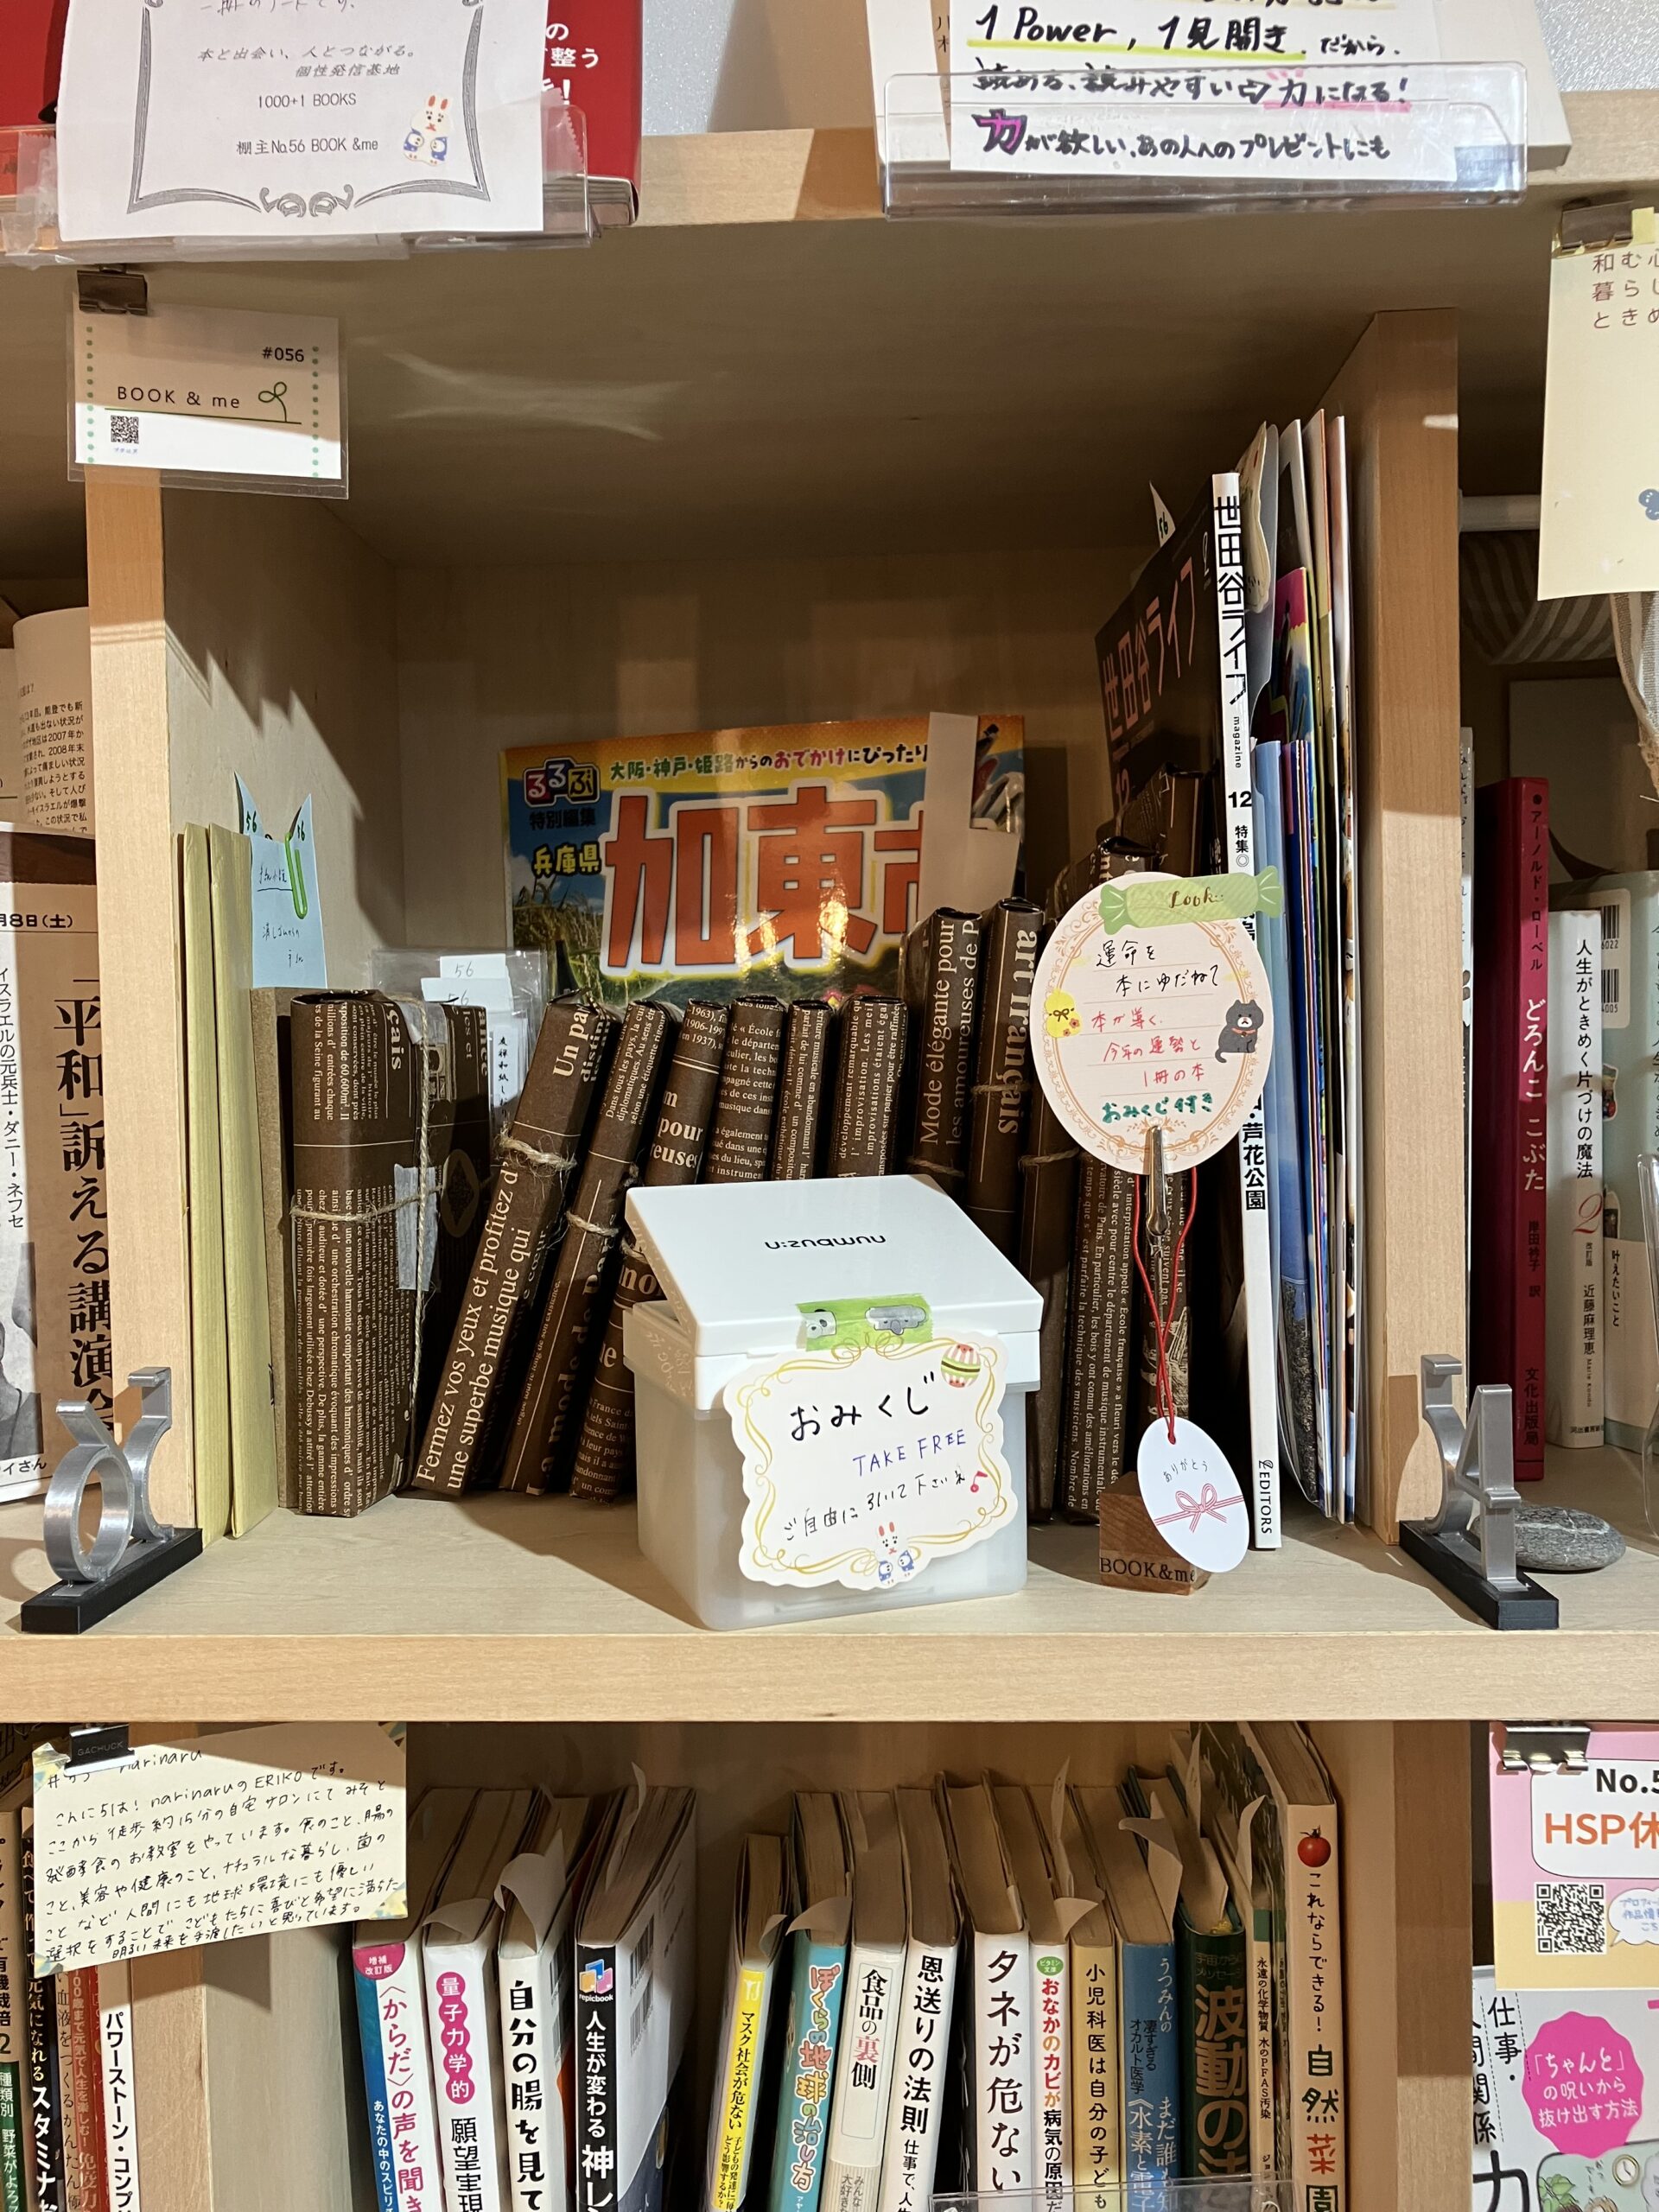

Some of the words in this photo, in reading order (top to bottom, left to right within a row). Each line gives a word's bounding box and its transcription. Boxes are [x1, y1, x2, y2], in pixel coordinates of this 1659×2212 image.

[296, 63, 401, 78] 個性発信基地
[544, 47, 600, 69] 整う
[257, 93, 306, 109] 1000+1
[312, 92, 357, 108] BOOKS
[311, 137, 347, 152] BOOK
[353, 137, 378, 151] &me
[262, 346, 305, 363] #056
[118, 386, 175, 404] BOOK
[187, 391, 200, 406] &
[213, 395, 240, 409] me
[1232, 716, 1242, 768] magazine
[529, 810, 596, 830] 特別編集
[1228, 791, 1252, 809] 12
[532, 842, 602, 877] 兵庫県
[454, 960, 474, 978] 56
[937, 918, 958, 975] pour
[959, 941, 979, 971] de
[1013, 929, 1039, 984] art
[1096, 939, 1157, 968] 運命を
[926, 976, 952, 1075] élégante
[950, 976, 976, 1114] amoureuses
[314, 1040, 323, 1067] Seine
[552, 1044, 580, 1077] Un
[1575, 938, 1593, 1179] 人生がときめく片づけの魔法
[313, 1070, 323, 1107] figurant
[616, 1058, 643, 1122] diplomatiques.
[838, 1081, 854, 1160] développement
[847, 1014, 861, 1079] remarquable
[864, 1071, 881, 1156] improvisations
[919, 1076, 944, 1147] Mode
[658, 1116, 705, 1143] pour
[945, 1115, 963, 1147] les
[480, 1189, 514, 1276] profitez
[305, 1285, 315, 1330] largement
[473, 1276, 490, 1298] et
[455, 1301, 486, 1358] yeux
[329, 1332, 340, 1389] chromatique
[342, 1333, 353, 1386] comportant
[444, 1359, 467, 1402] vos
[447, 1449, 470, 1490] une
[460, 1363, 494, 1446] superbe
[484, 1268, 520, 1359] musique
[511, 1227, 532, 1263] qui
[790, 1370, 936, 1441] おみくじ
[342, 1406, 354, 1468] harmoniques
[416, 1401, 455, 1484] Fermez
[852, 1445, 907, 1477] TAKE
[916, 1428, 967, 1459] FREE
[1082, 1430, 1095, 1497] améliorations
[1068, 1448, 1080, 1493] Nombre
[77, 1740, 124, 1757] GACHUCK
[365, 1965, 393, 1975] 改訂版
[1306, 1872, 1328, 2033] これならできる!
[578, 1993, 614, 2004] repicbook
[1156, 1957, 1174, 2033] うつみんの
[1256, 1956, 1270, 2032] 永遠の化学物質
[441, 1976, 471, 2100] 量子力学的
[850, 1968, 889, 2091] 食品の裏側
[899, 1955, 944, 2135] 恩送りの法則
[1129, 2018, 1145, 2095] オカルト医学
[585, 2010, 607, 2139] 人生が変わる
[728, 2011, 756, 2130] マスク社会が危ない
[791, 1965, 842, 2192] ぼくらの地球の治し方
[986, 1949, 1024, 2193] タネが危ない
[1534, 2046, 1626, 2079] 「ちゃんと」
[1543, 2076, 1627, 2101] の呪いから
[105, 2012, 132, 2212] パワーストーン・コンプ
[509, 1979, 546, 2210] 自分の腸を見て
[1537, 2097, 1639, 2130] 抜け出す方法
[896, 2139, 920, 2212] 仕事で、人
